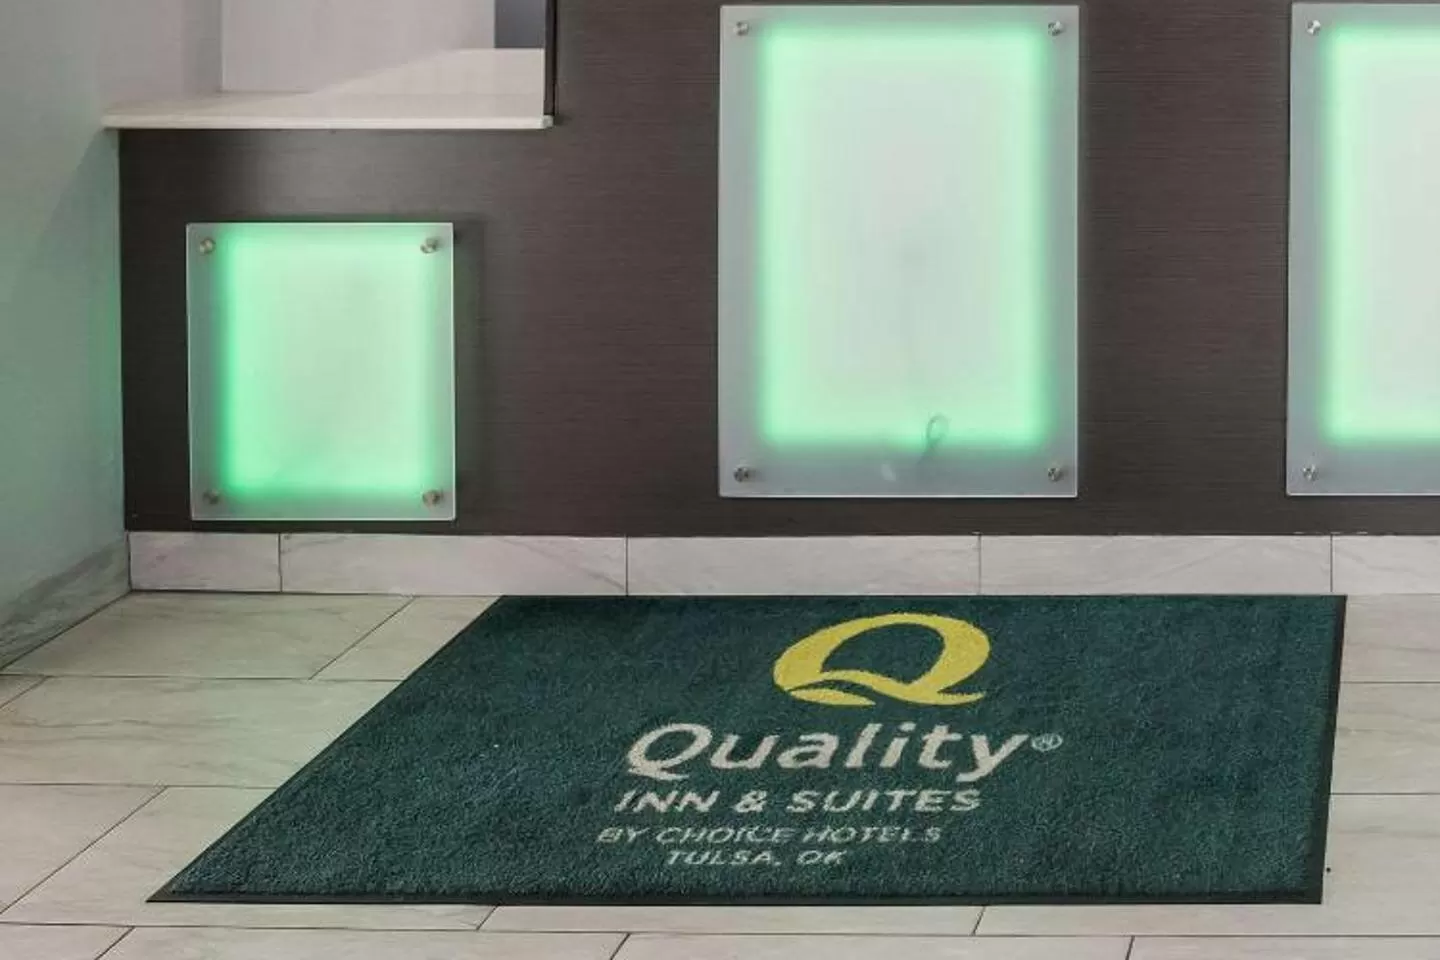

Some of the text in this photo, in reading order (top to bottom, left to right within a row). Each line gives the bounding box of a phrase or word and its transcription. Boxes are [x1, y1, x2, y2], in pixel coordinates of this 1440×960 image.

[774, 612, 991, 706] Q
[614, 788, 983, 814] INN & SUITES
[598, 825, 943, 844] BY CHOICE HOTELS
[796, 849, 850, 866] OK
